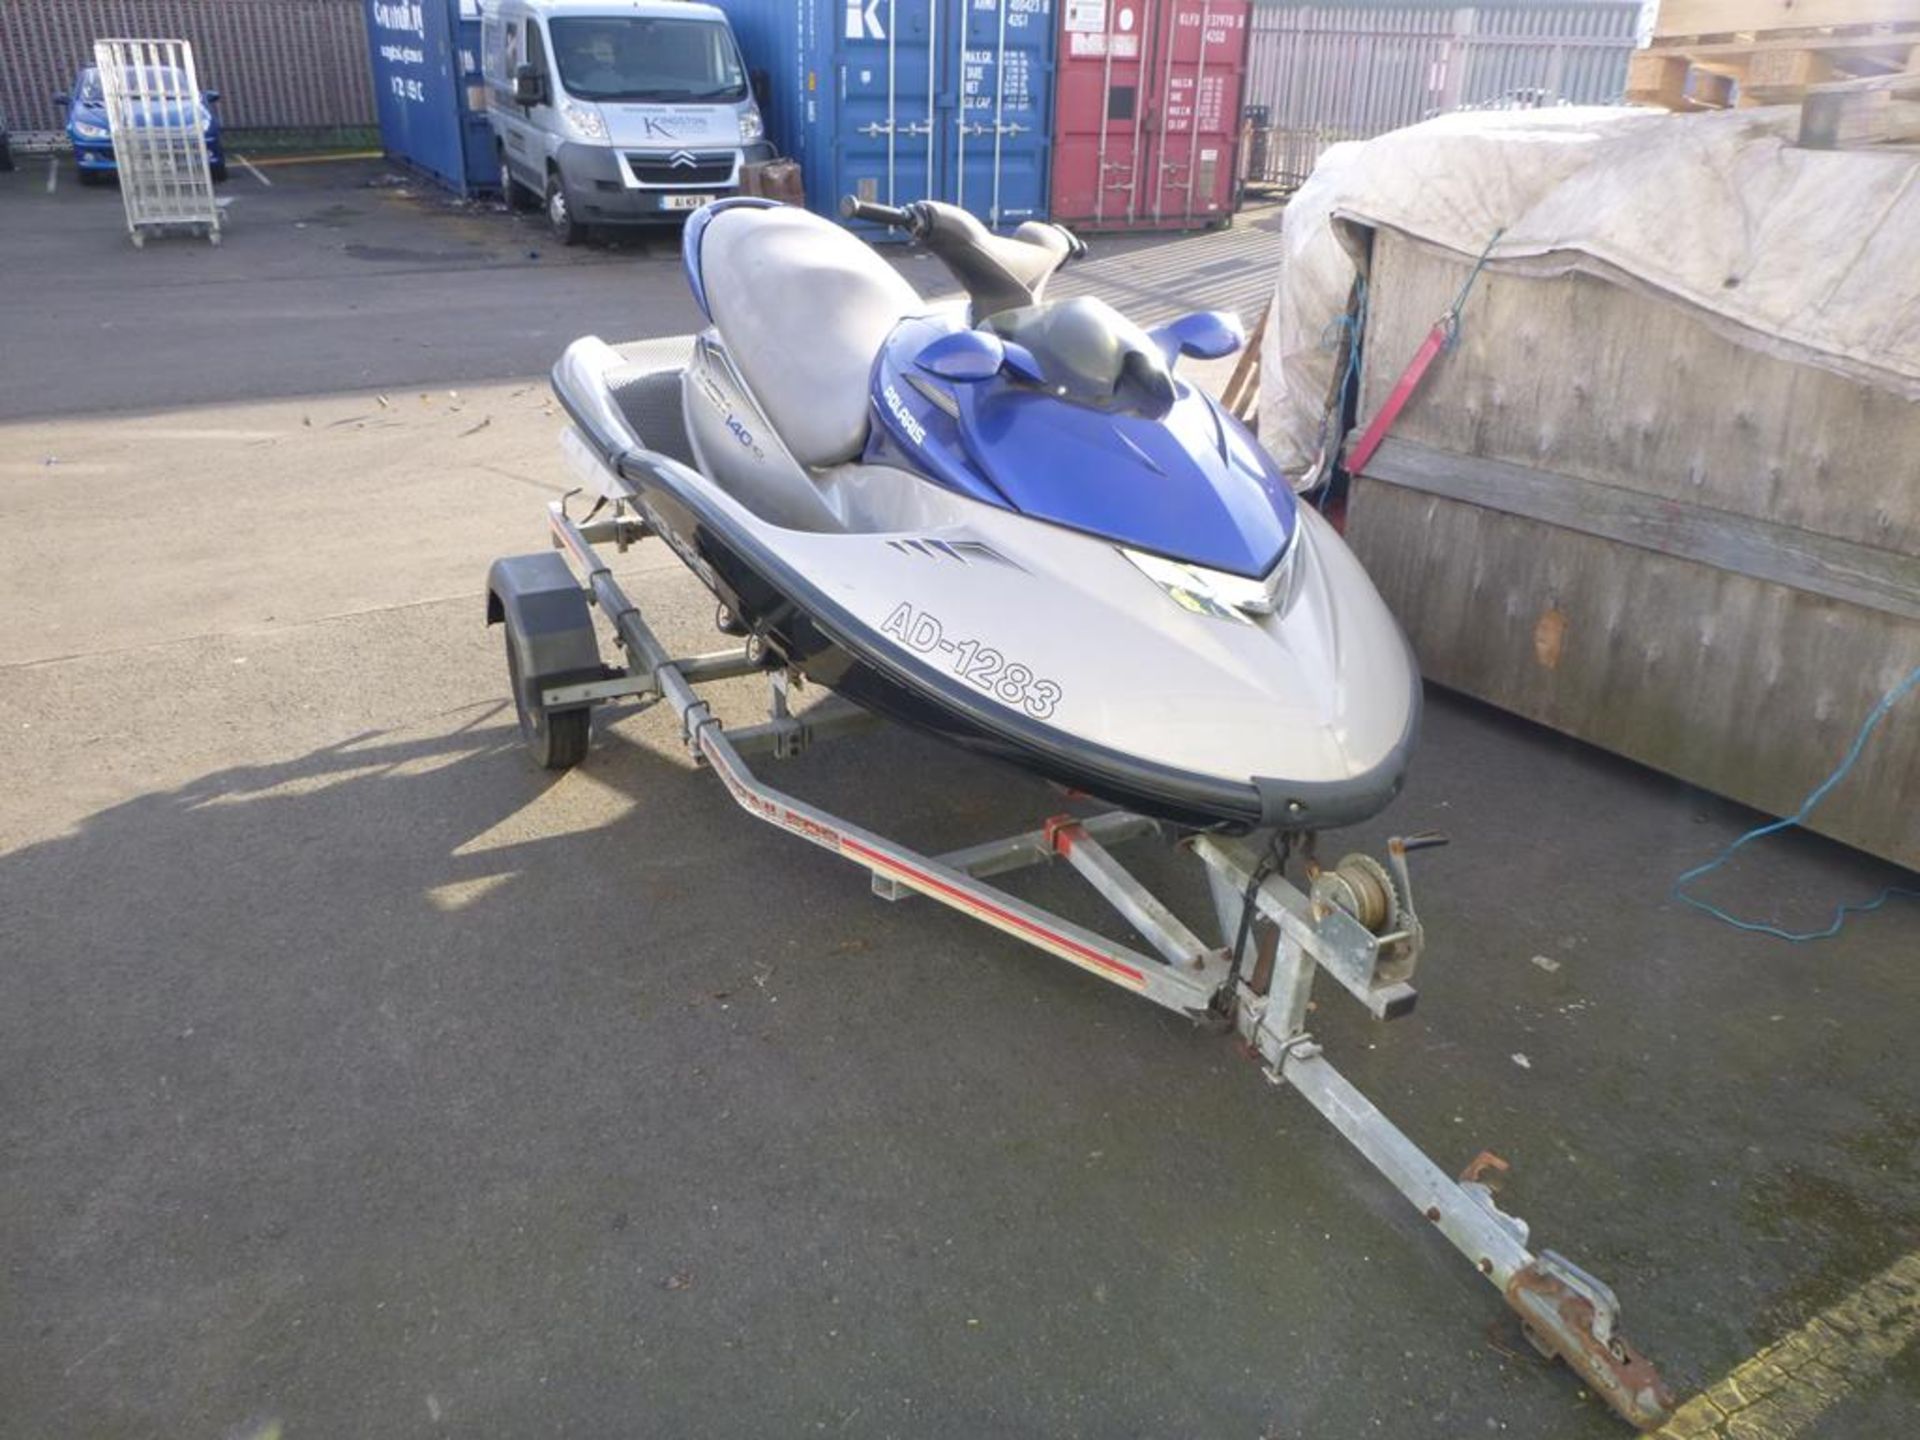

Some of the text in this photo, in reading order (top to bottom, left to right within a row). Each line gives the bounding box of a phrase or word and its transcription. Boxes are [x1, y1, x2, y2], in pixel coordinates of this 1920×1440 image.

[725, 413, 753, 447] 140
[883, 385, 926, 446] POLARIS
[881, 601, 1062, 719] AD-1283
